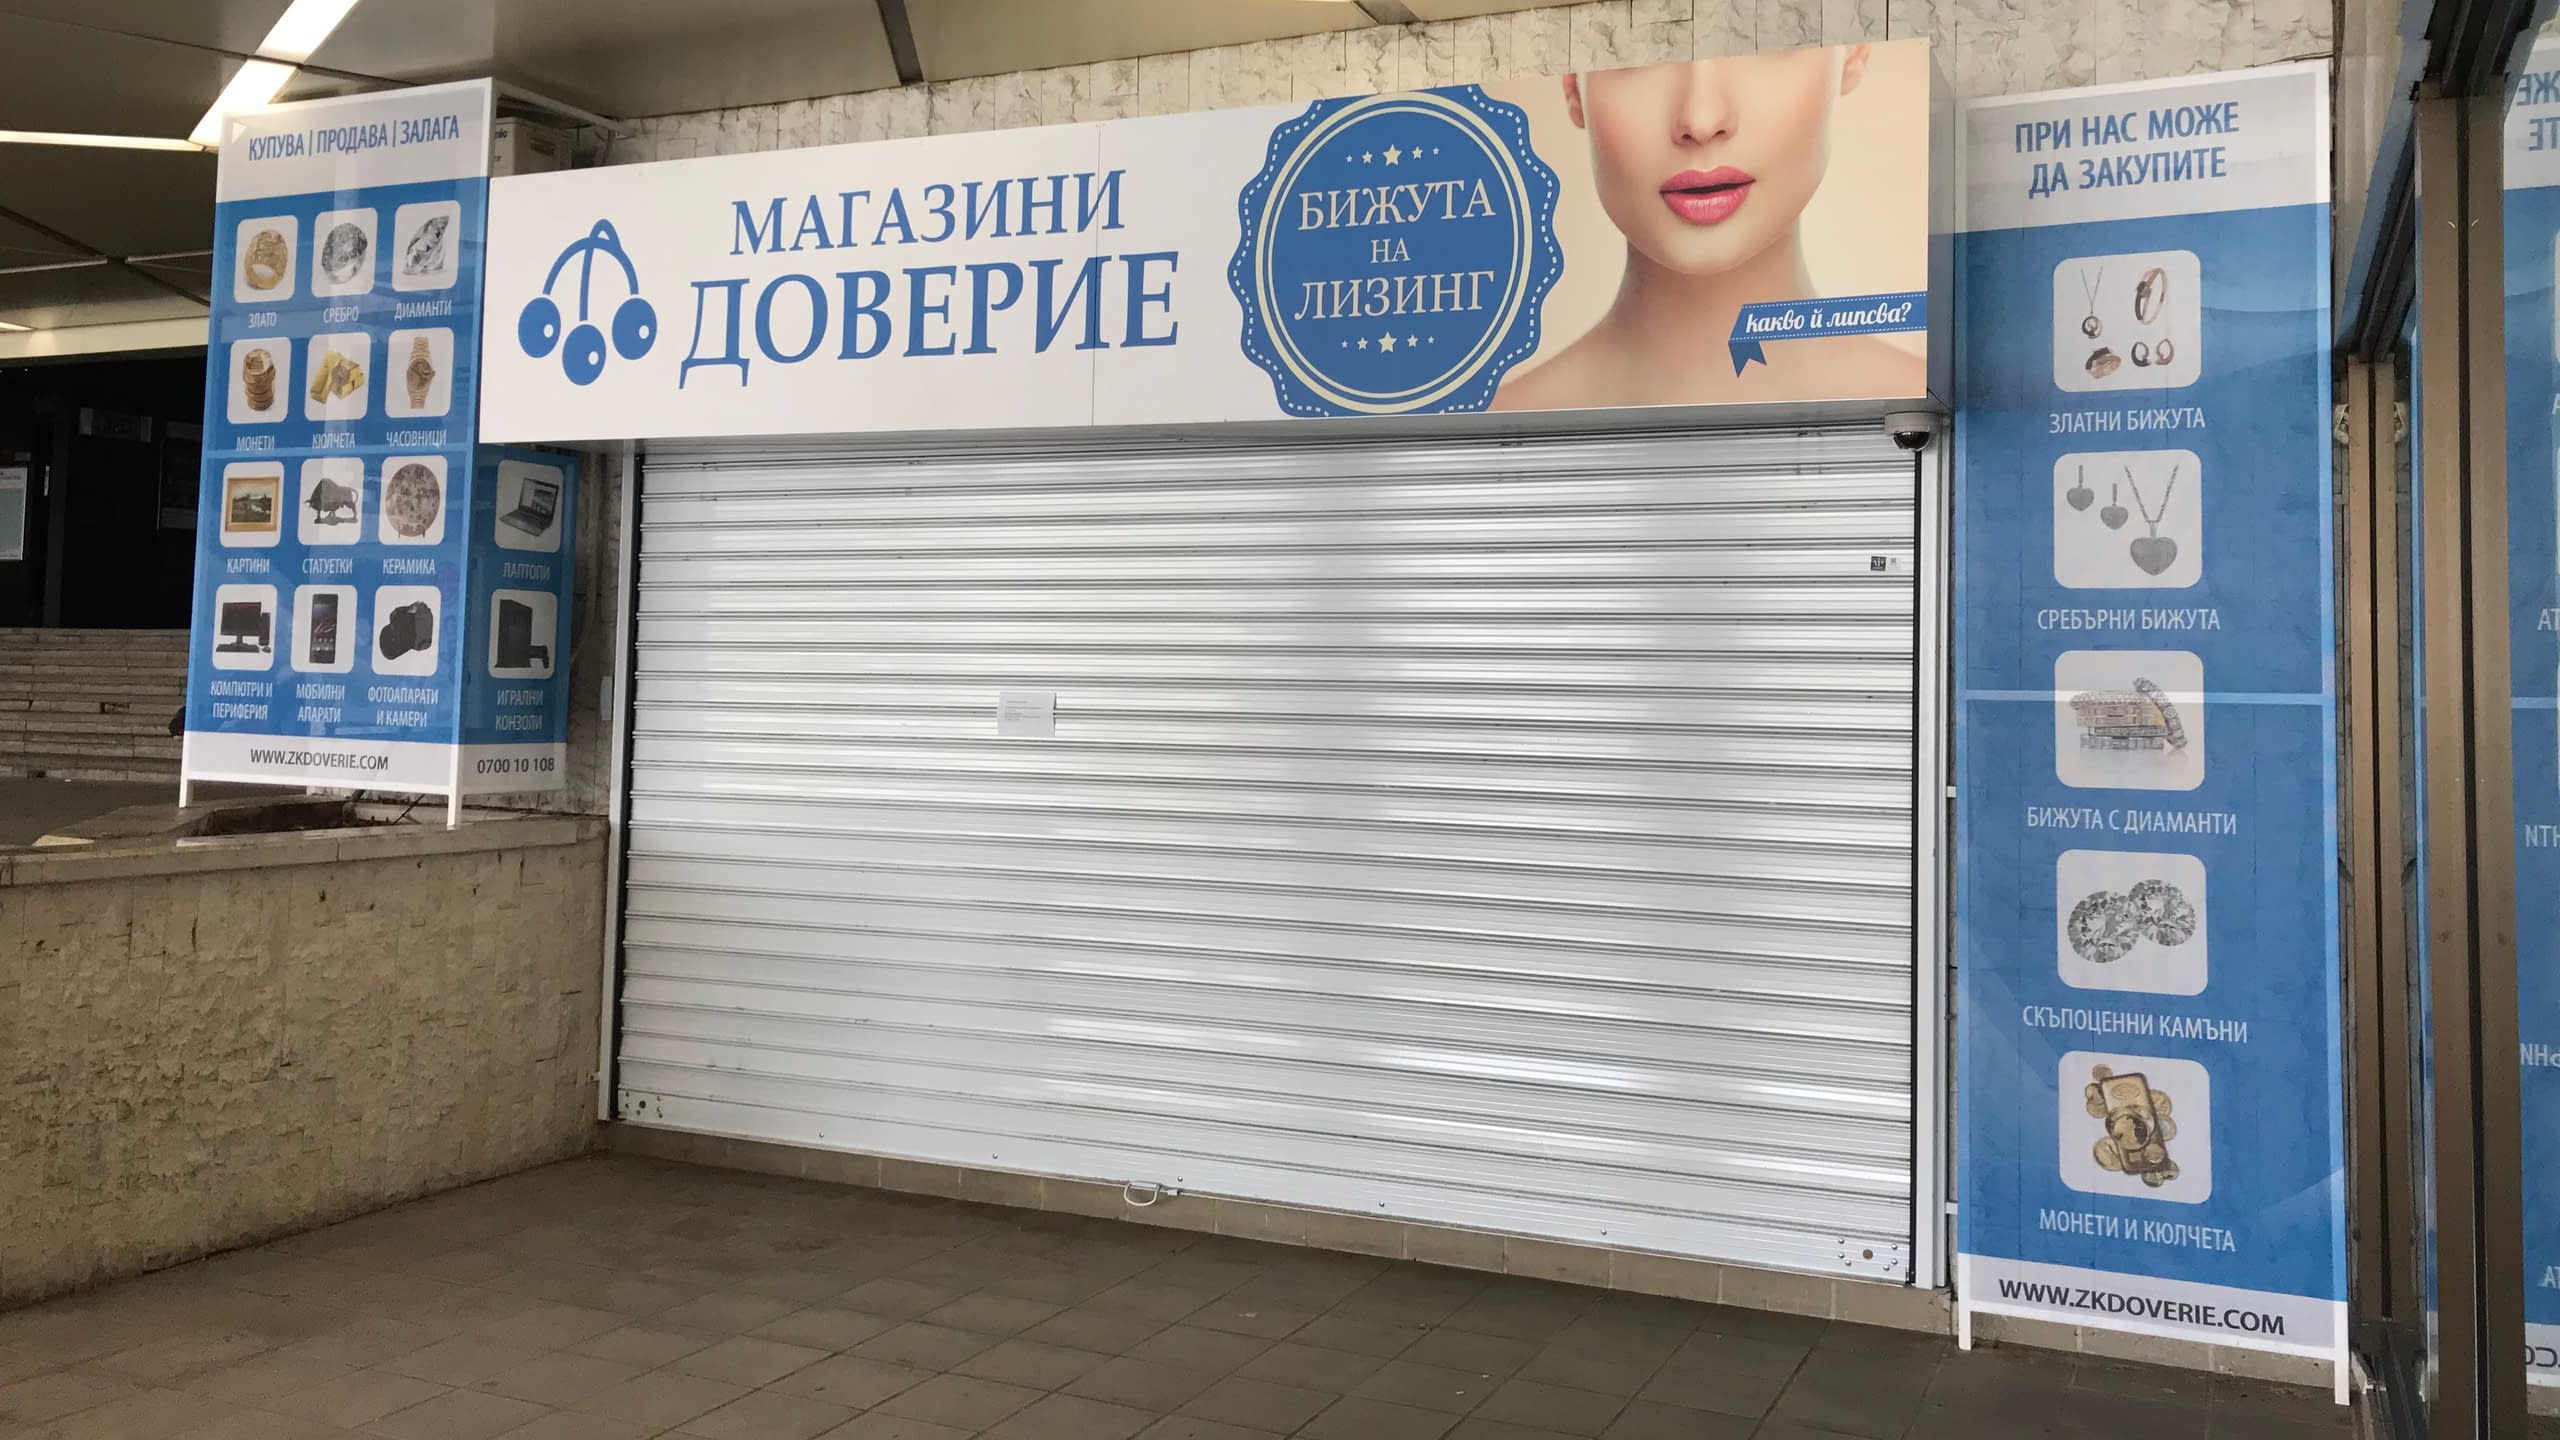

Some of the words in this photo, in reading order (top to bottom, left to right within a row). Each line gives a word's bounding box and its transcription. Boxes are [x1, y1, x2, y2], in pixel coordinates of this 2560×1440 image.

[2015, 119, 2071, 154] ПРИ
[2082, 112, 2137, 147] НАС
[2148, 101, 2240, 141] МОЖЕ
[249, 133, 304, 161] КУПУВА
[316, 125, 388, 155] ПРОДАВА
[400, 115, 459, 145] ЗАЛАГА
[2028, 162, 2069, 199] ДА
[2078, 146, 2227, 190] ЗАКУПИТЕ
[729, 169, 1126, 256] МАГАЗИНИ
[1298, 178, 1496, 231] БИЖУТА
[1370, 238, 1411, 264] НА
[1294, 270, 1495, 320] ЛИЗИНГ
[323, 306, 360, 324] СРЕБРО
[394, 300, 452, 320] ДИАМАНТИ
[1745, 309, 1805, 334] какво
[1826, 302, 1912, 328] липсва?
[248, 312, 277, 329] ЗЛАТО
[679, 251, 1179, 390] ДОВЕРИЕ
[2049, 411, 2121, 434] ЗЛАТНИ
[2127, 407, 2205, 431] БИЖУТА
[236, 435, 275, 452] МОНЕТИ
[312, 432, 356, 449] КЮЛЧЕТА
[386, 429, 447, 448] ЧАСОВНИЦИ
[227, 558, 270, 574] КАРТИНИ
[302, 558, 353, 574] СТАТУЕТКИ
[383, 558, 436, 575] КЕРАМИКА
[502, 563, 551, 581] ЛАПТОПИ
[2037, 608, 2135, 630] СРЕБЪРНИ
[2141, 608, 2220, 631] БИЖУТА
[210, 681, 263, 698] КОМПЮТРИ
[264, 683, 273, 698] И
[296, 683, 345, 701] МОБИЛНИ
[367, 686, 439, 705] ФОТОАПАРАТИ
[497, 689, 544, 706] ИГРАЛНИ
[212, 703, 268, 721] ПЕРИФЕРИЯ
[297, 706, 341, 724] АПАРАТИ
[376, 711, 384, 727] И
[386, 711, 428, 728] КАМЕРИ
[495, 713, 543, 731] КОНЗОЛИ
[250, 749, 389, 771] WWW.ZKDOVERIE.COM
[477, 758, 509, 774] 0700
[514, 758, 530, 773] 10
[533, 757, 555, 773] 108
[2027, 806, 2103, 829] БИЖУТА
[2108, 809, 2120, 830] С
[2124, 810, 2237, 835] ДИАМАНТИ
[2023, 1005, 2154, 1036] СКЪПОЦЕННИ
[2159, 1015, 2248, 1044] КАМЪНИ
[2039, 1209, 2119, 1239] МОНЕТИ
[2125, 1219, 2138, 1241] И
[2144, 1220, 2236, 1252] КЮЛЧЕТА
[1998, 1278, 2286, 1336] WWW.ZKDOVERIE.COM
